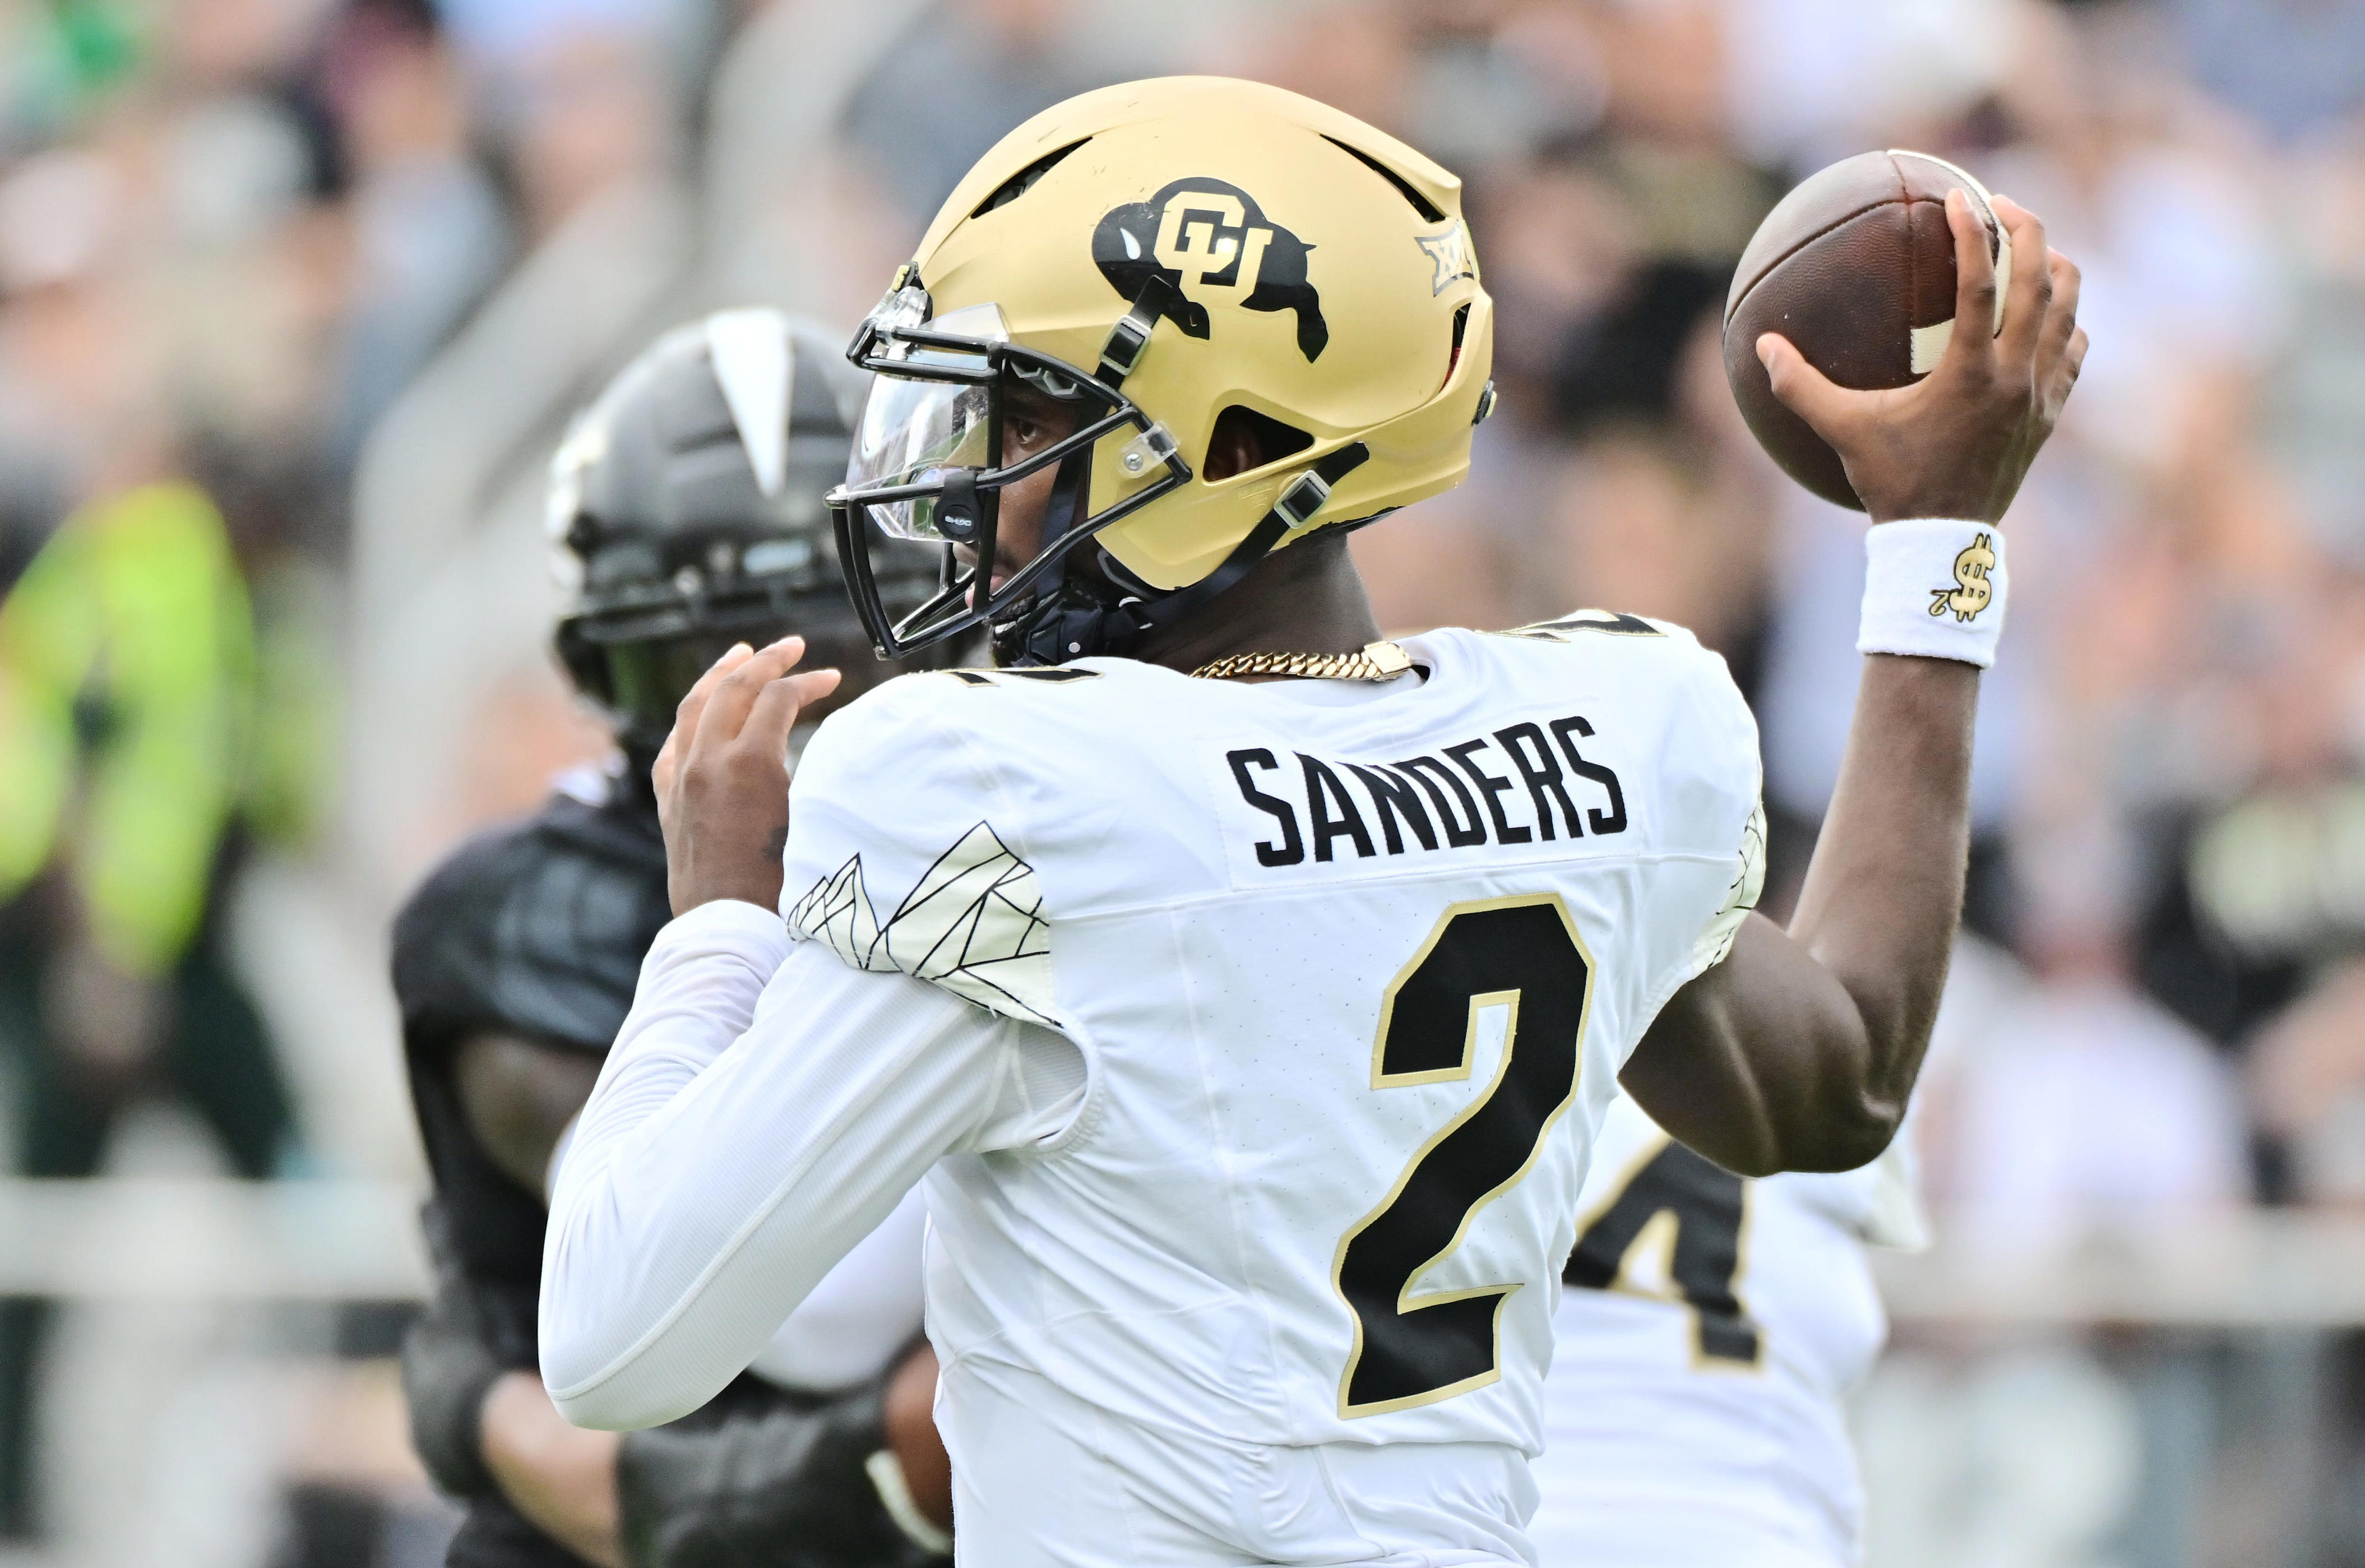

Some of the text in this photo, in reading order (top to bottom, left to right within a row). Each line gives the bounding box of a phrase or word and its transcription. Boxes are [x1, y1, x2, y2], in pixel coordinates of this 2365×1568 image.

[1153, 191, 1274, 308] CU
[1226, 715, 1627, 867] SANDERS
[1330, 890, 1597, 1421] 2
